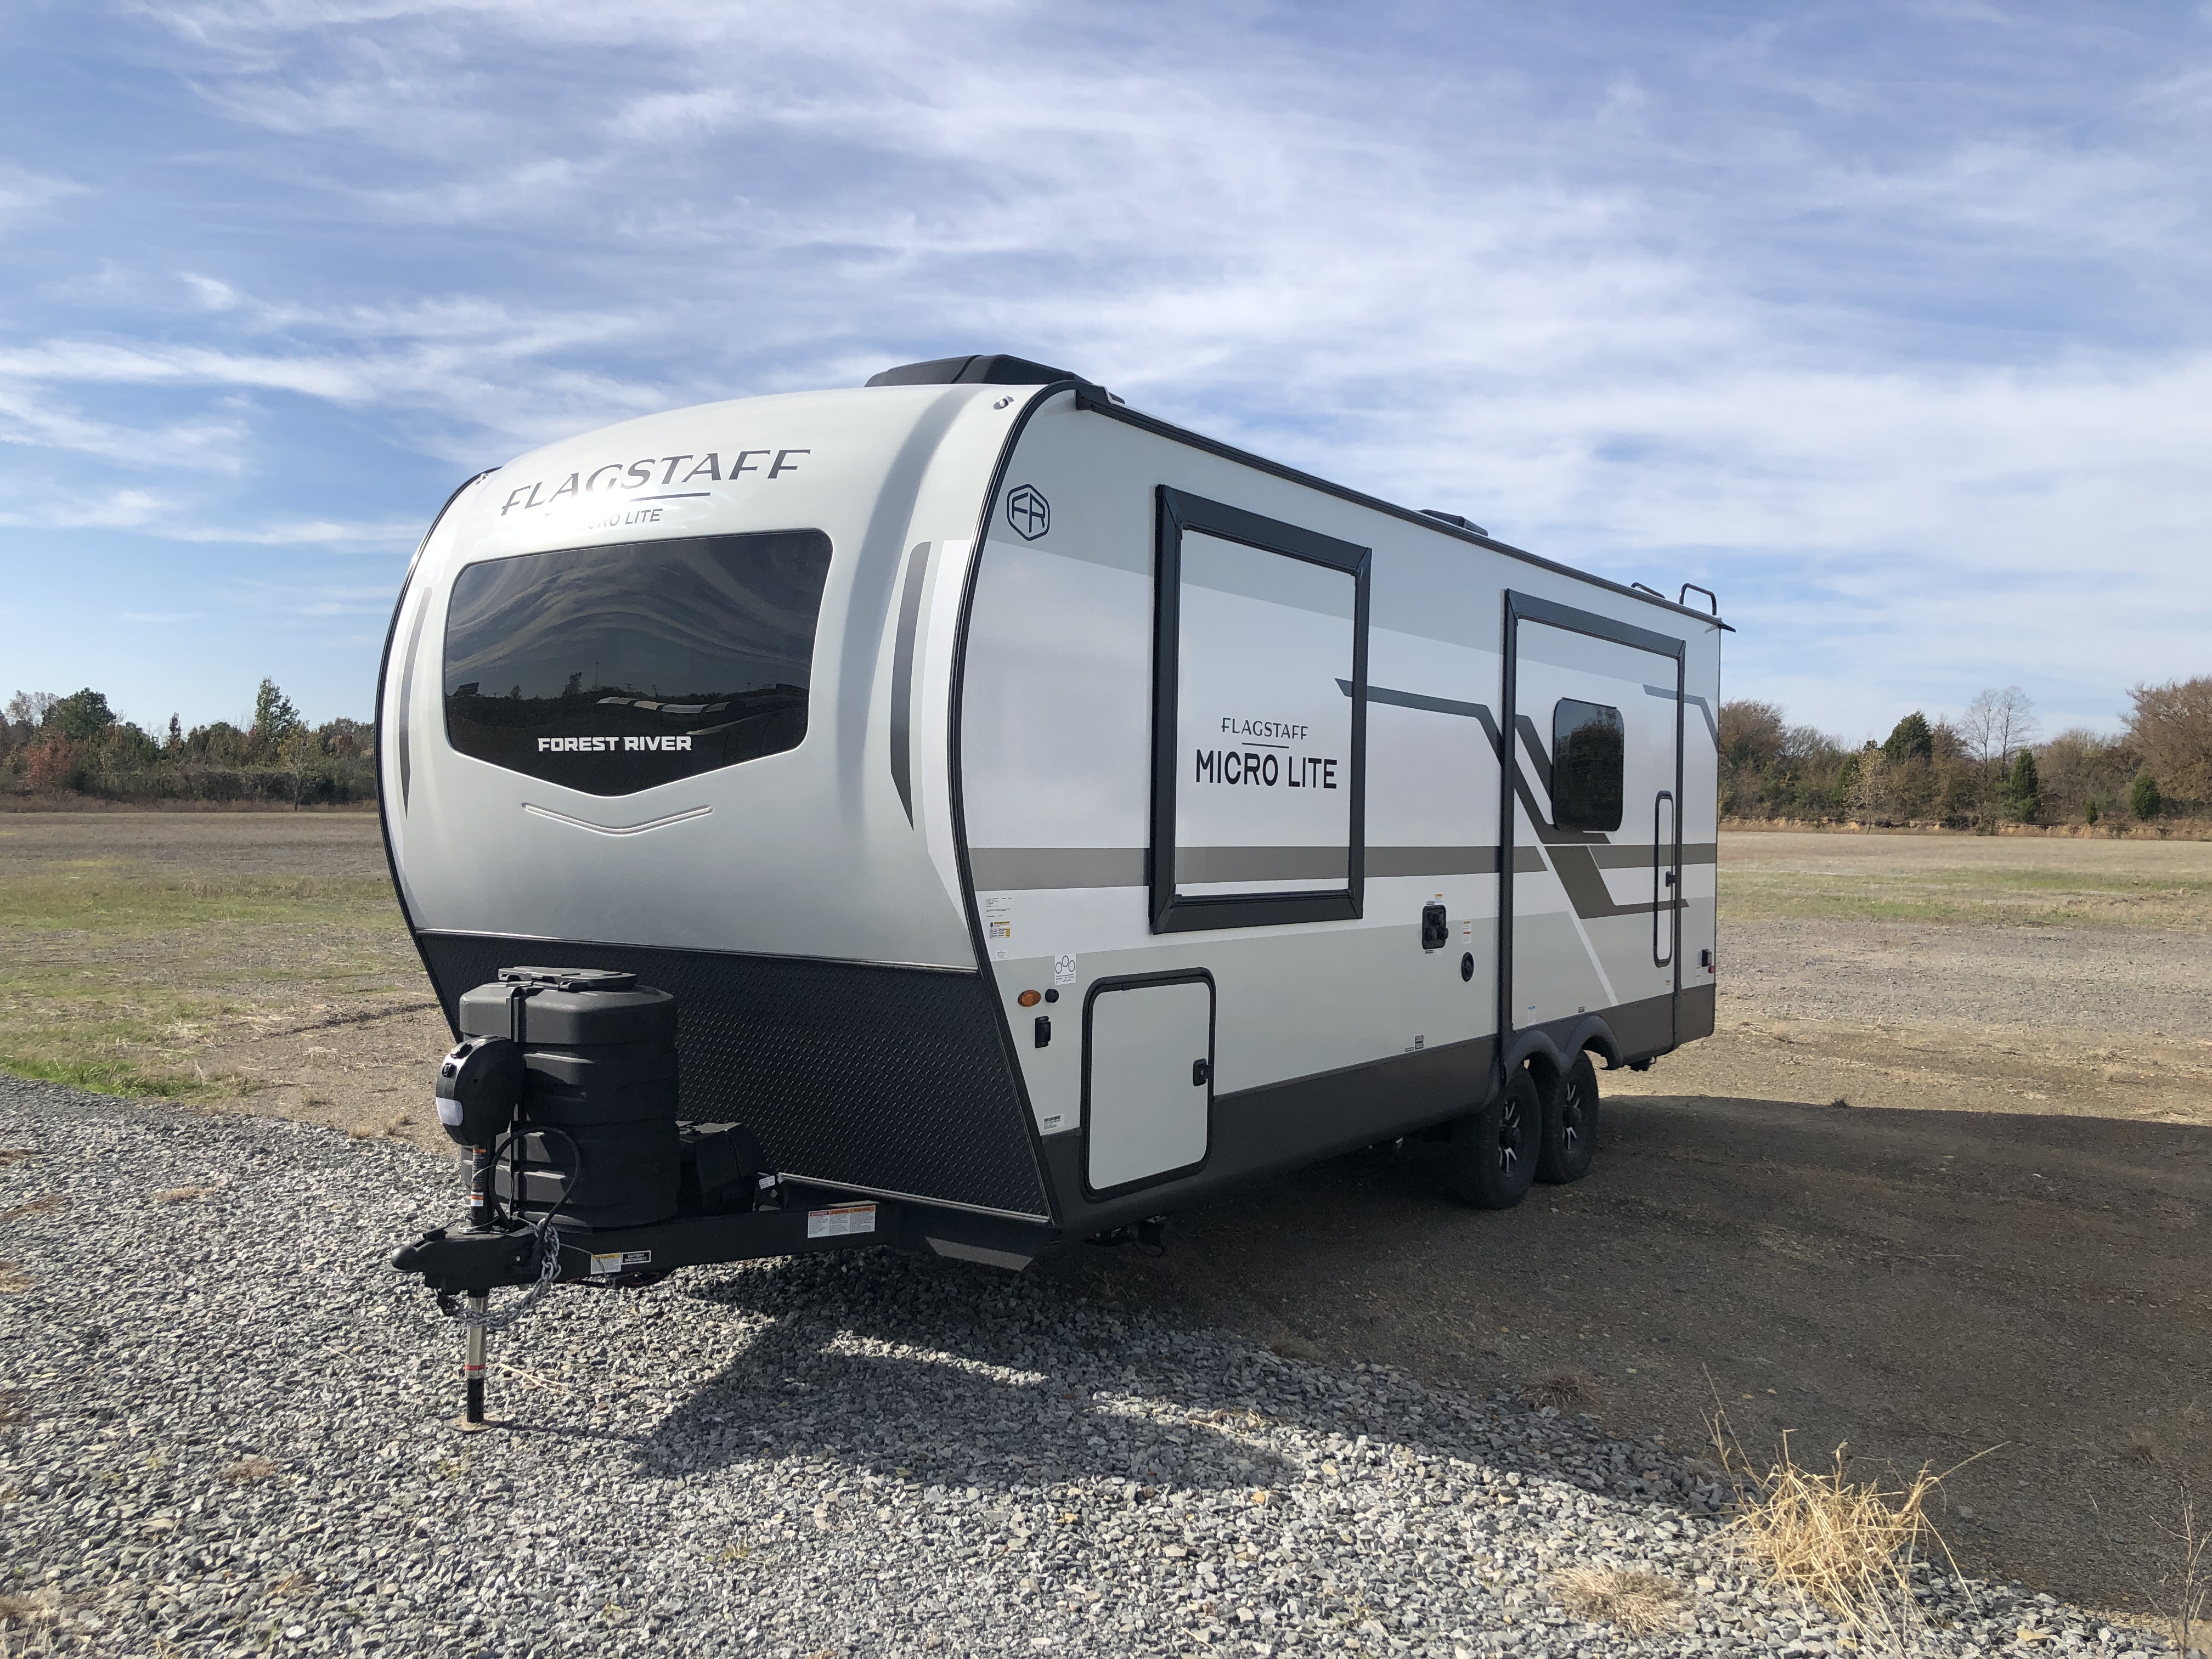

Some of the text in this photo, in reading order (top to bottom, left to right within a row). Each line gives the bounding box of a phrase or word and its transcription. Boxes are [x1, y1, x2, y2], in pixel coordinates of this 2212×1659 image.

[500, 449, 811, 516] FLAGSTAFF
[625, 509, 663, 524] LITE
[1221, 717, 1308, 740] FLAGSTAFF
[538, 736, 692, 752] FOREST RIVER
[1196, 749, 1337, 789] MICRO LITE
